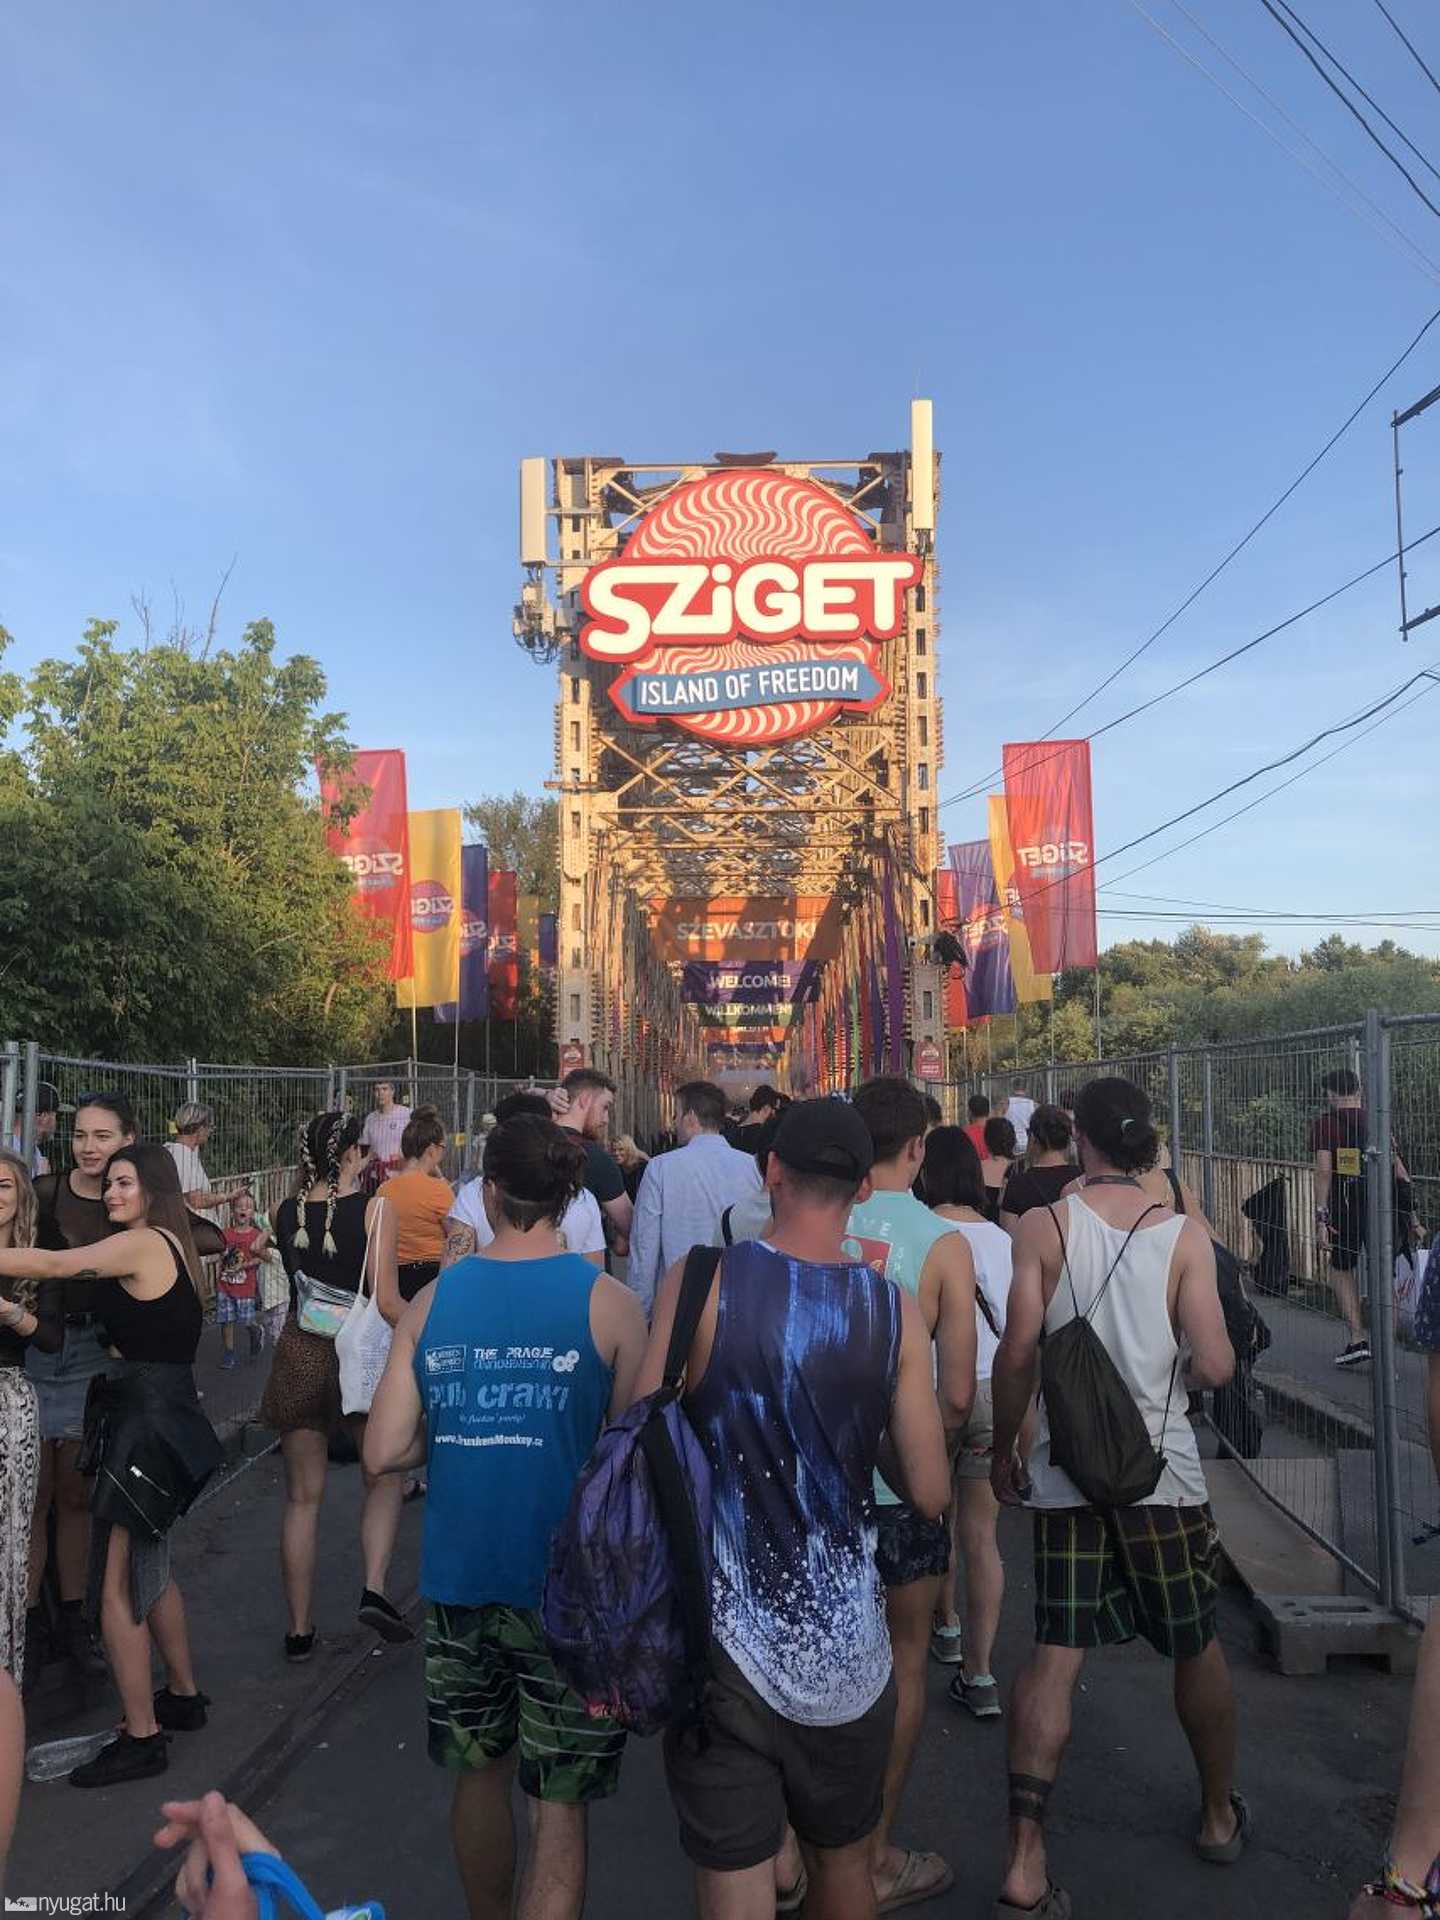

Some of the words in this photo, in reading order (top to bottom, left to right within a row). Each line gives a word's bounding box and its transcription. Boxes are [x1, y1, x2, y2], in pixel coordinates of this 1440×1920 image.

[641, 677, 719, 706] ISLAND
[725, 673, 751, 699] OF
[758, 666, 859, 696] FREEDOM
[473, 1348, 499, 1361] THE
